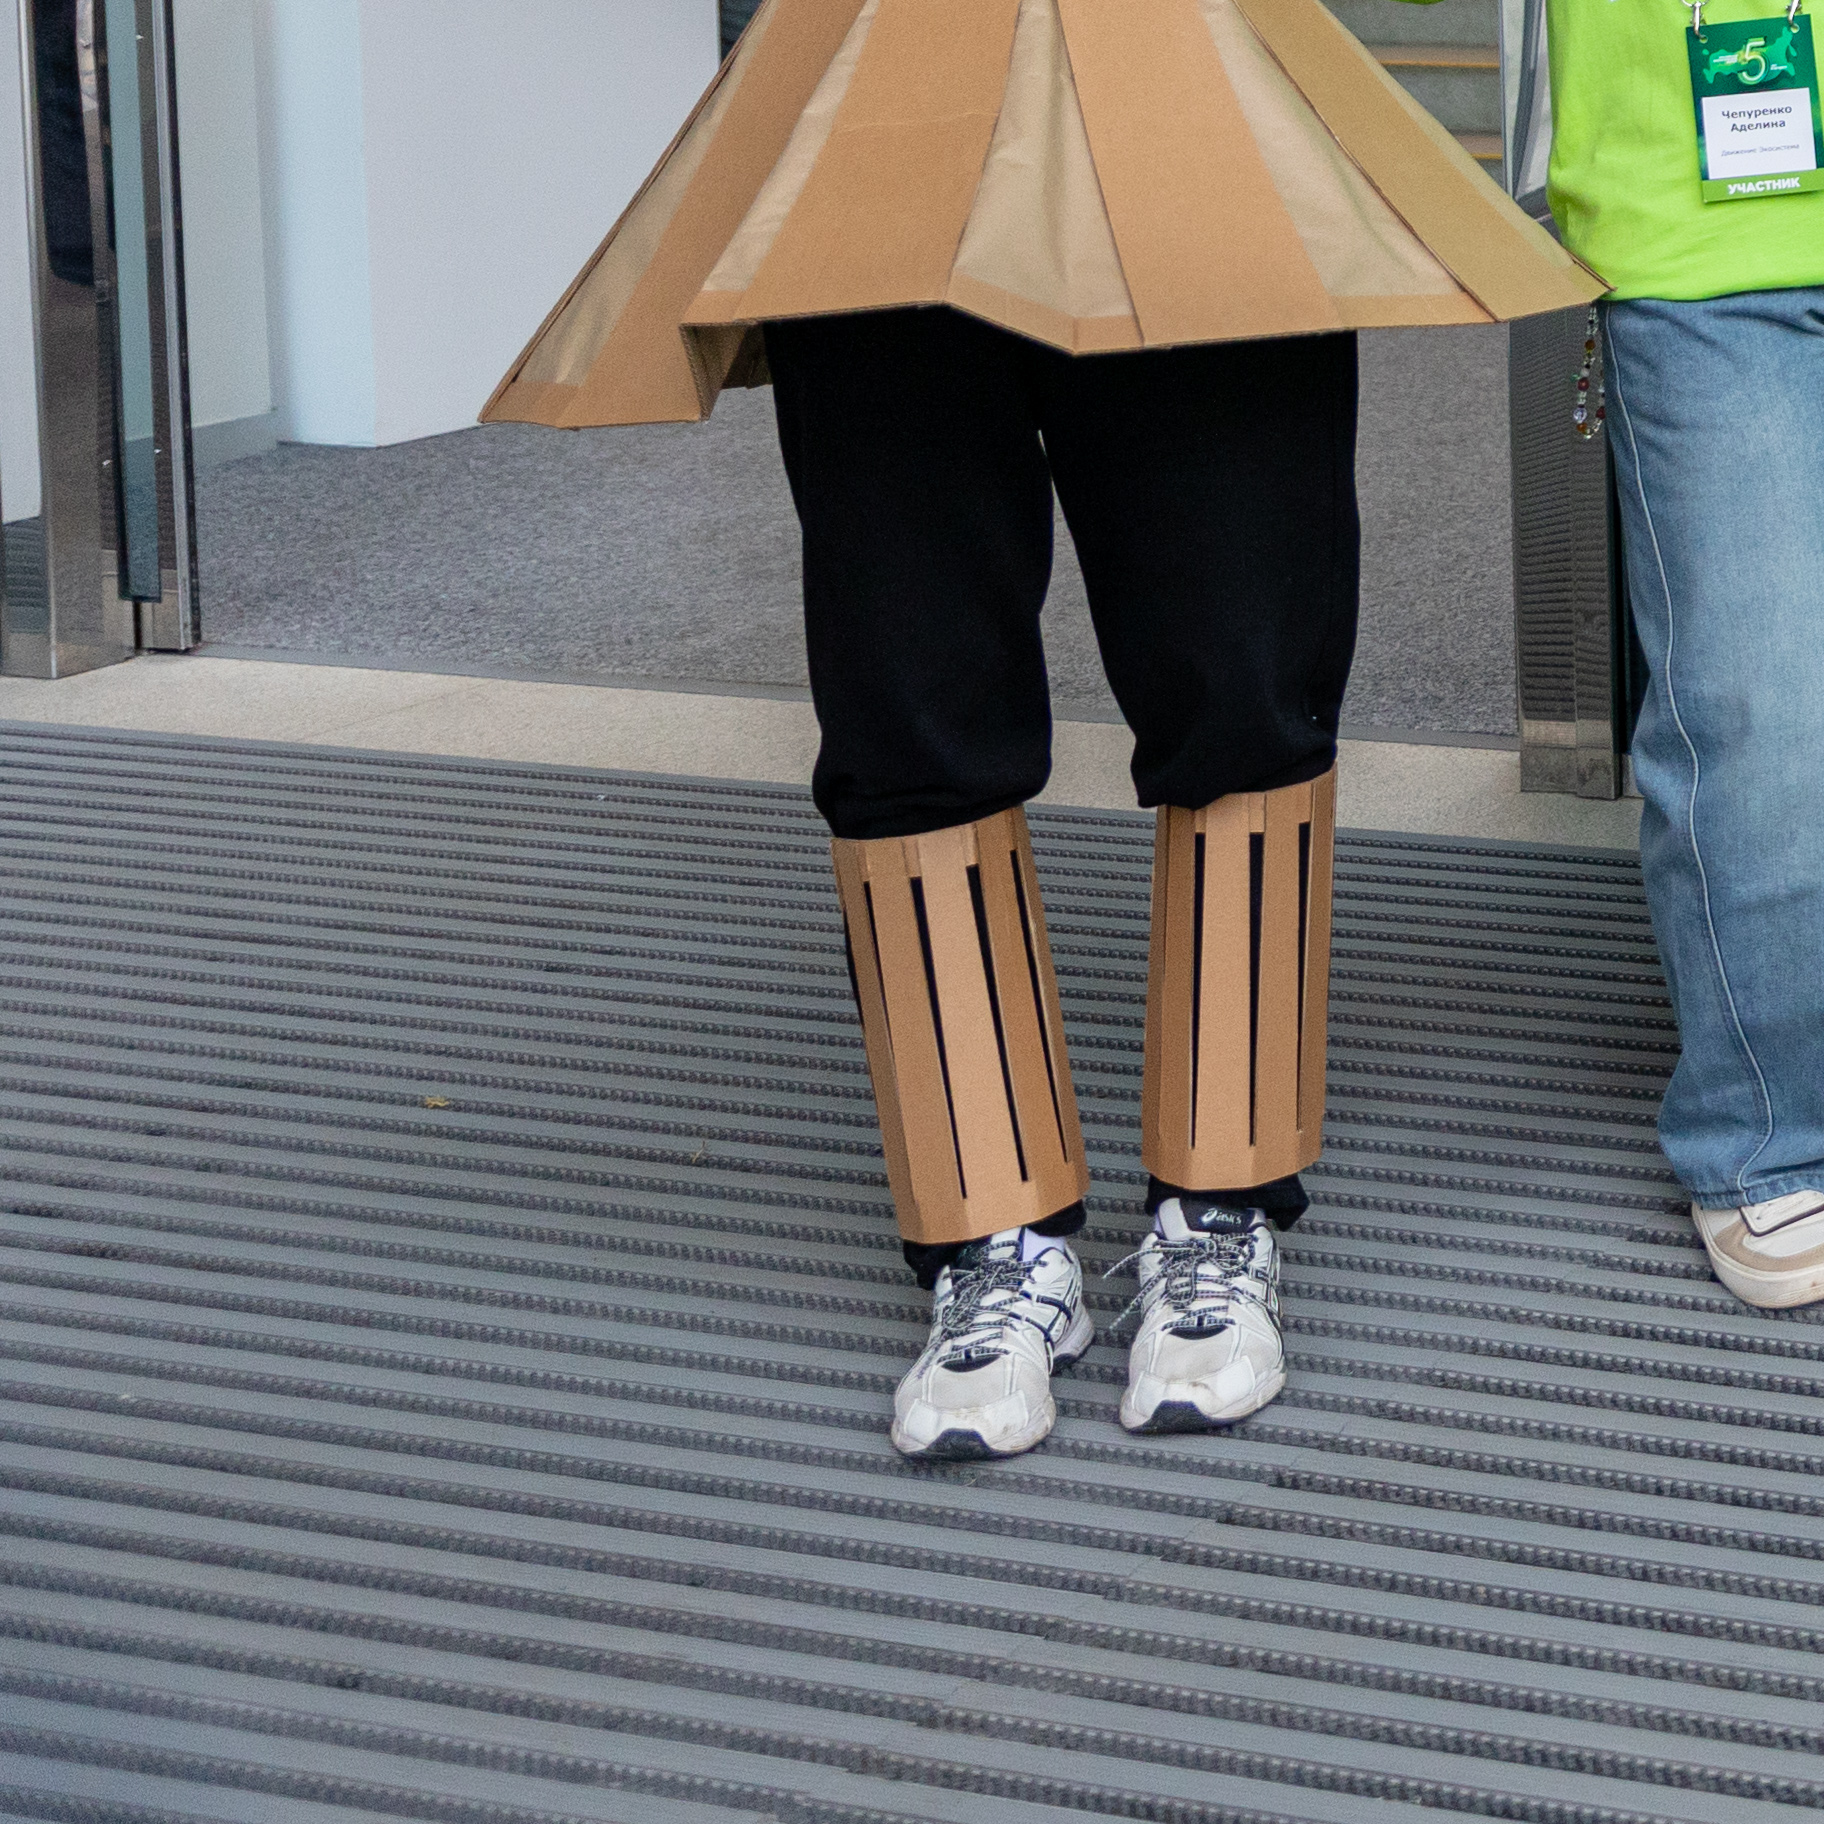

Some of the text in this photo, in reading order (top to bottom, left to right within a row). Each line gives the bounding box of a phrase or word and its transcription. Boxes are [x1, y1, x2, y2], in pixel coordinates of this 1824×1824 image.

[1738, 37, 1767, 84] 5
[1721, 105, 1793, 120] Чепуренко
[1730, 119, 1786, 133] Аделина
[1728, 177, 1801, 195] УЧАСТНИК
